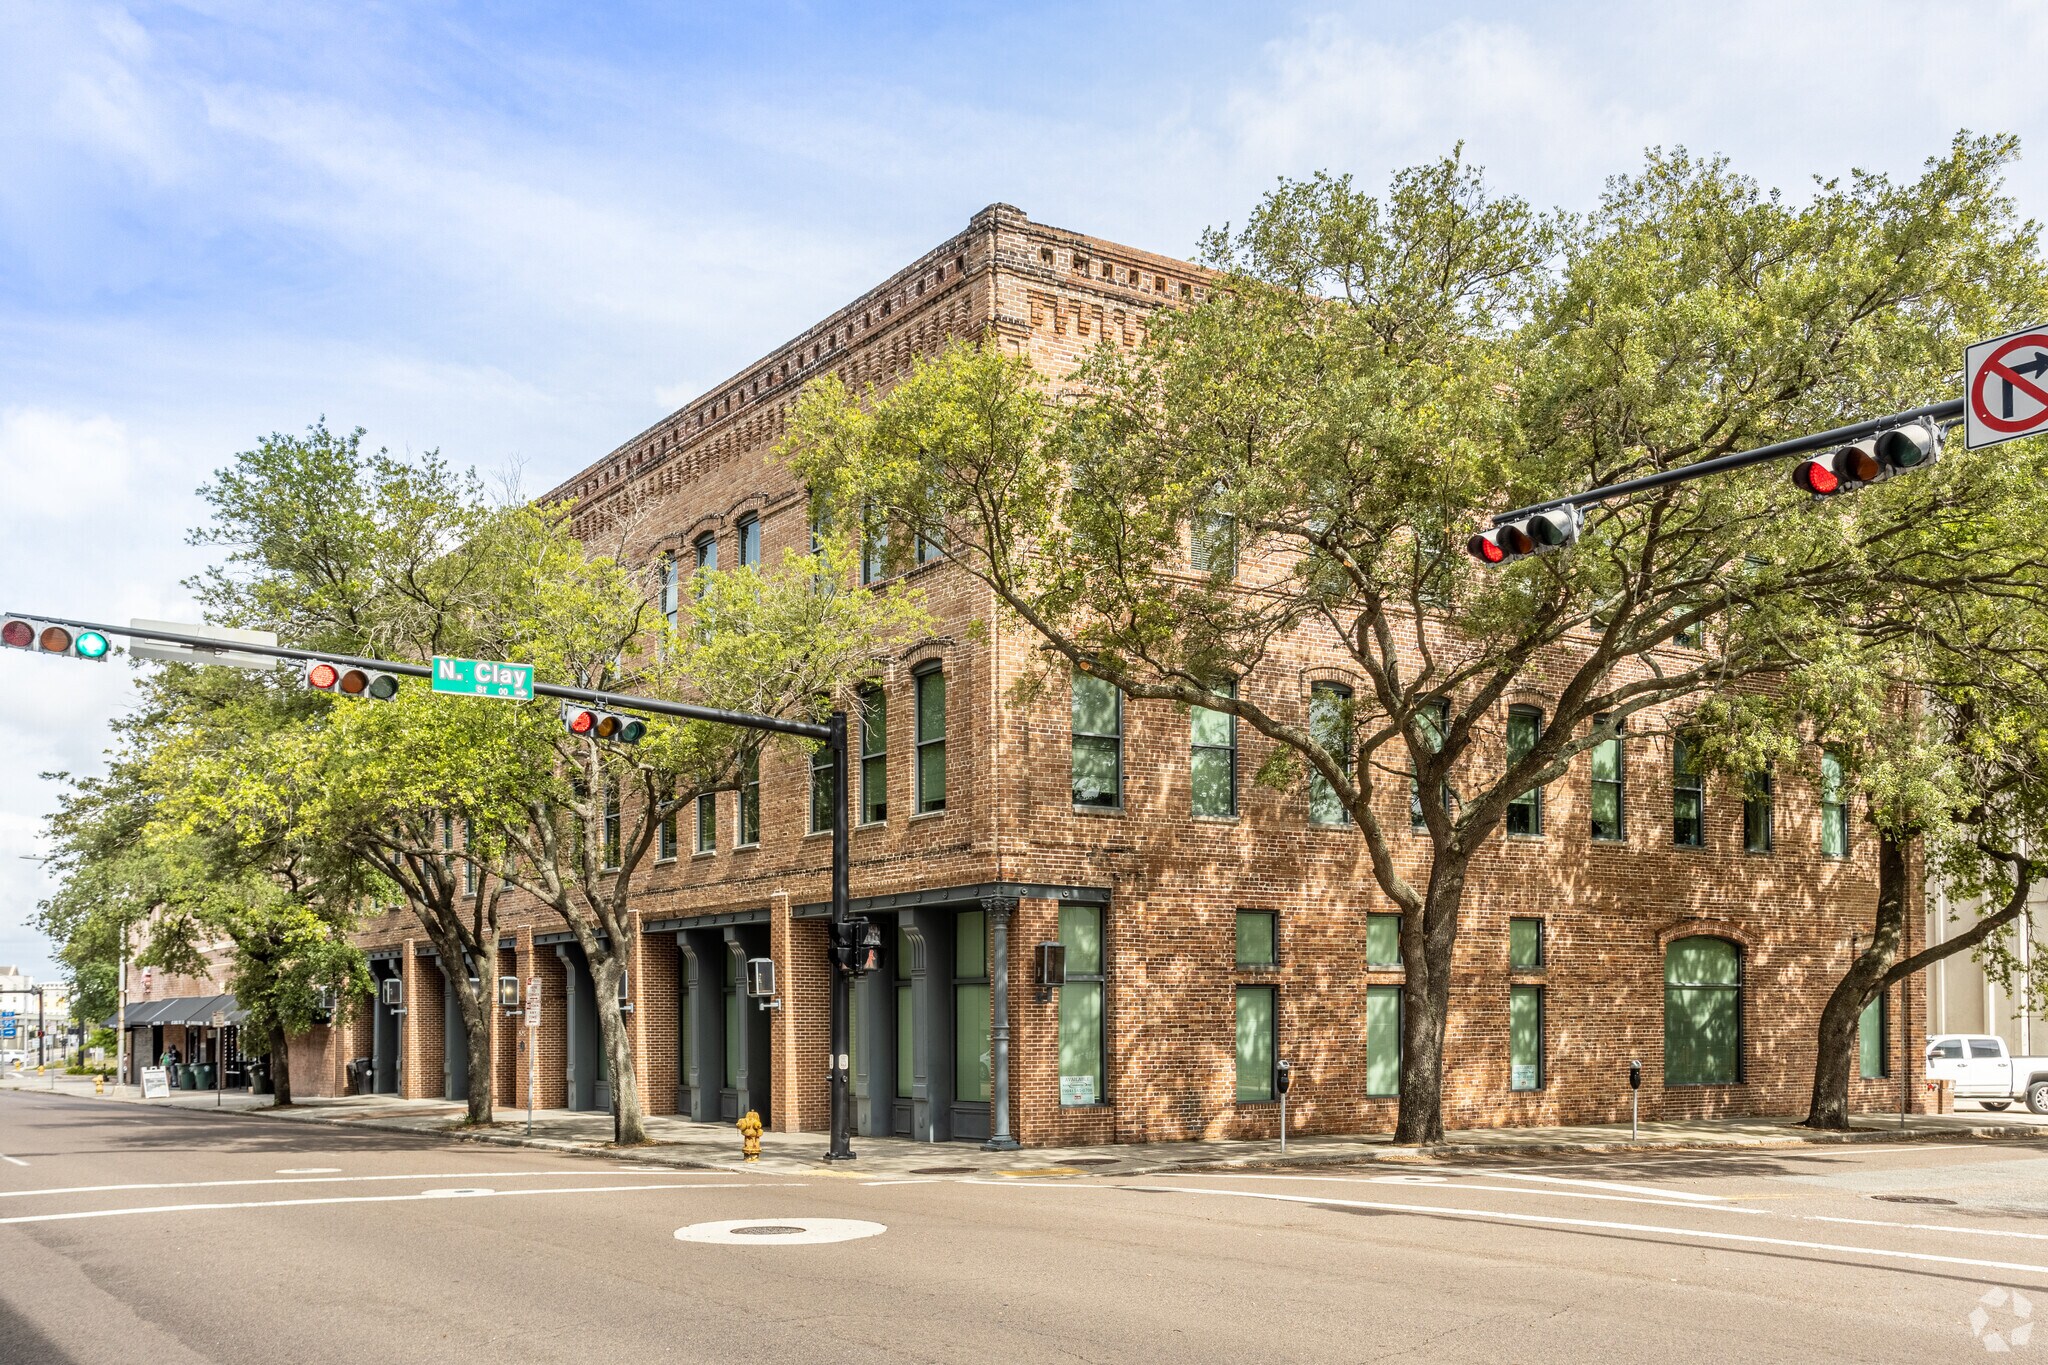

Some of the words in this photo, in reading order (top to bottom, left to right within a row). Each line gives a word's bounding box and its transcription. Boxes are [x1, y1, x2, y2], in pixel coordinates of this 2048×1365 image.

[439, 660, 463, 680] N.
[475, 663, 526, 688] Clay
[476, 685, 487, 694] St
